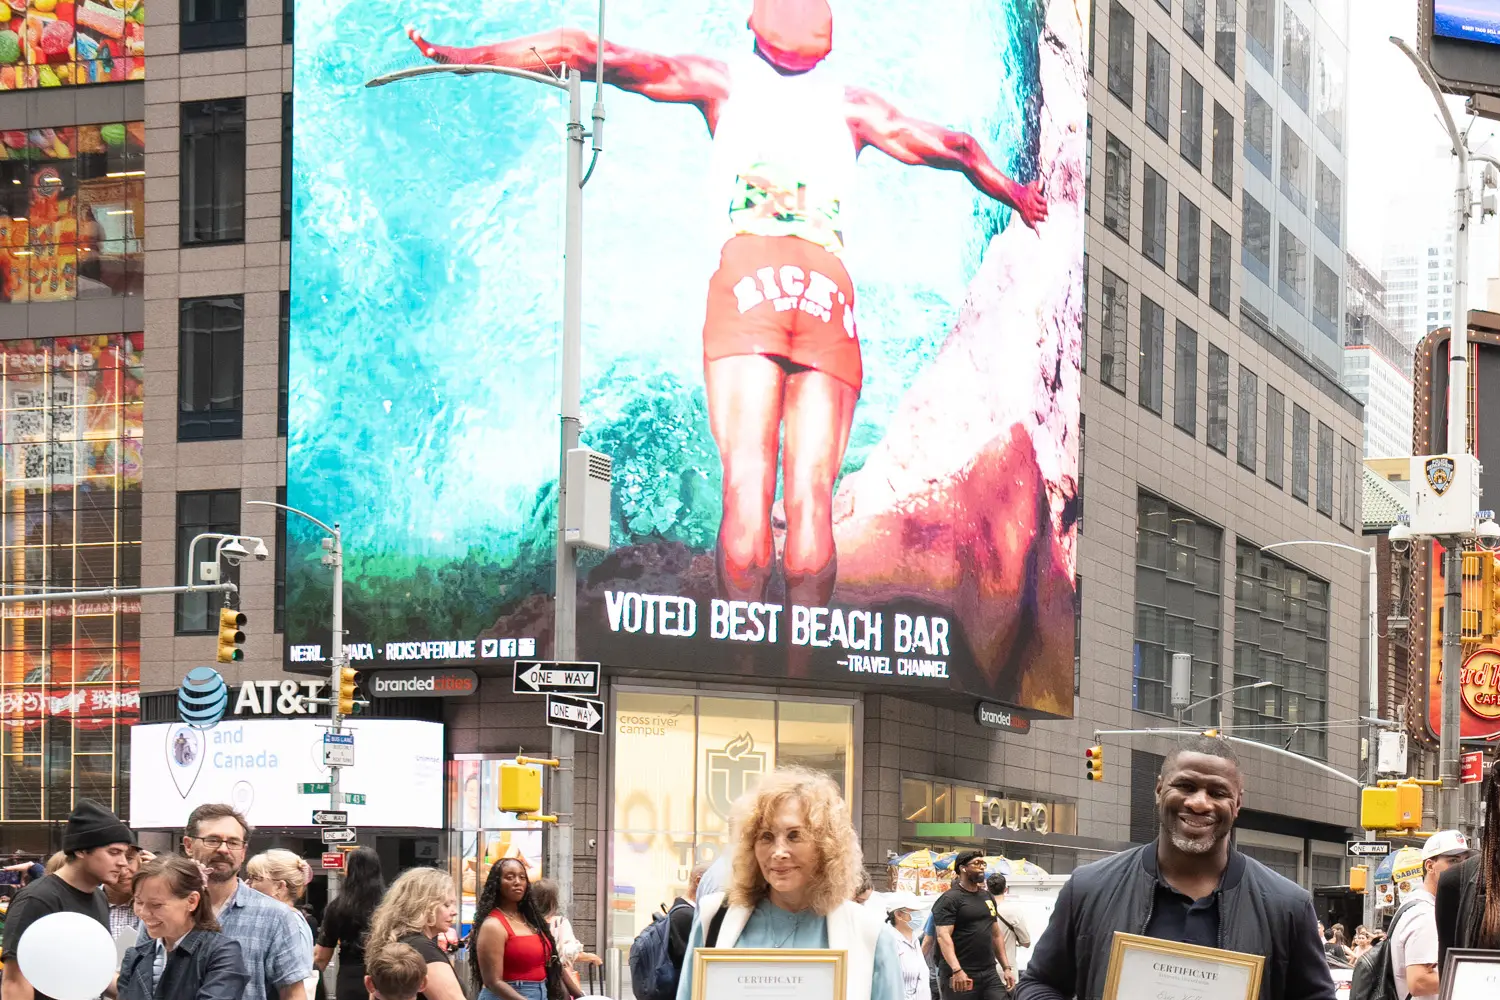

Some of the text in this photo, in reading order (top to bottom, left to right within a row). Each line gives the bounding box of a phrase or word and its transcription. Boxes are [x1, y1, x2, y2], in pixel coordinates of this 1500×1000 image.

[1476, 510, 1492, 518] NYPD
[604, 590, 950, 656] VOTED BEST BEACH BAR
[897, 658, 949, 679] CHANNEL
[1438, 662, 1488, 688] ard
[530, 671, 589, 684] ONE WAY
[234, 679, 326, 715] AT&T
[553, 704, 594, 722] ONE WAY
[620, 715, 678, 727] cross river
[213, 726, 243, 744] and
[620, 726, 665, 737] campus
[213, 750, 278, 769] Canada
[310, 784, 315, 792] 7
[346, 794, 351, 804] W
[352, 794, 360, 804] 43
[334, 814, 345, 822] WAY
[972, 794, 1048, 835] TOURO
[1396, 866, 1423, 880] SABRE
[1152, 962, 1219, 981] CERTIFICATE
[737, 976, 805, 984] CERTIFICATE
